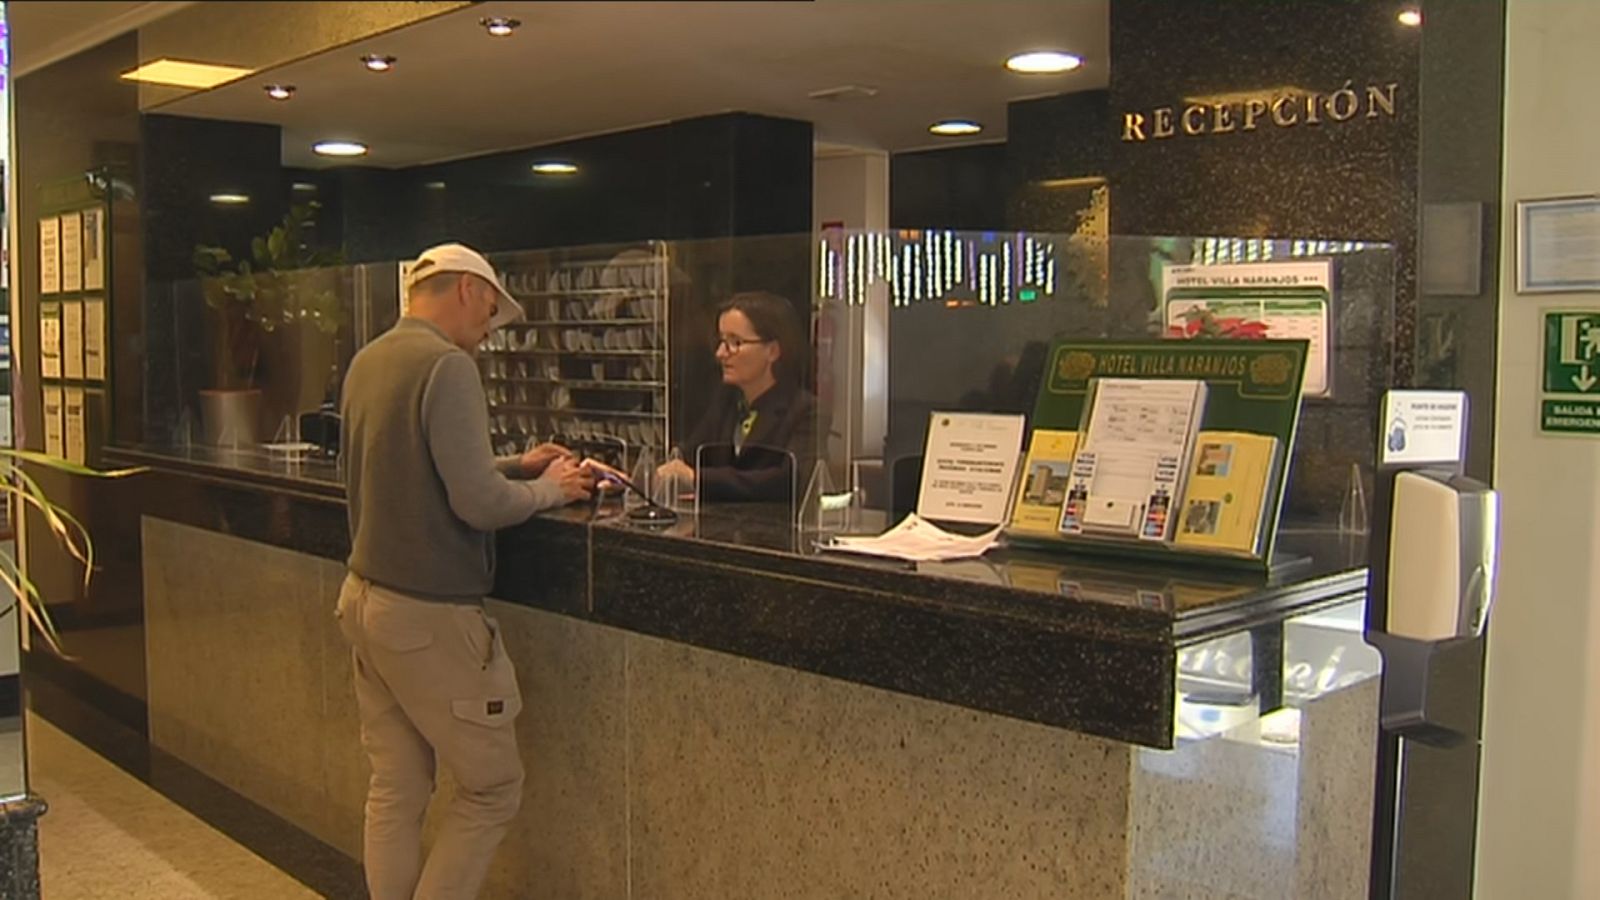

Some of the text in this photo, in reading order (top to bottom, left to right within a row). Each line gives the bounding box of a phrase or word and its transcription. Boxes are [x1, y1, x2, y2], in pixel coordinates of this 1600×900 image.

[1121, 80, 1398, 141] RECEPCIÓN
[1176, 275, 1299, 286] HOTEL VILLA NARANJOS
[1101, 353, 1247, 376] HOTEL VILLA NARANJOS
